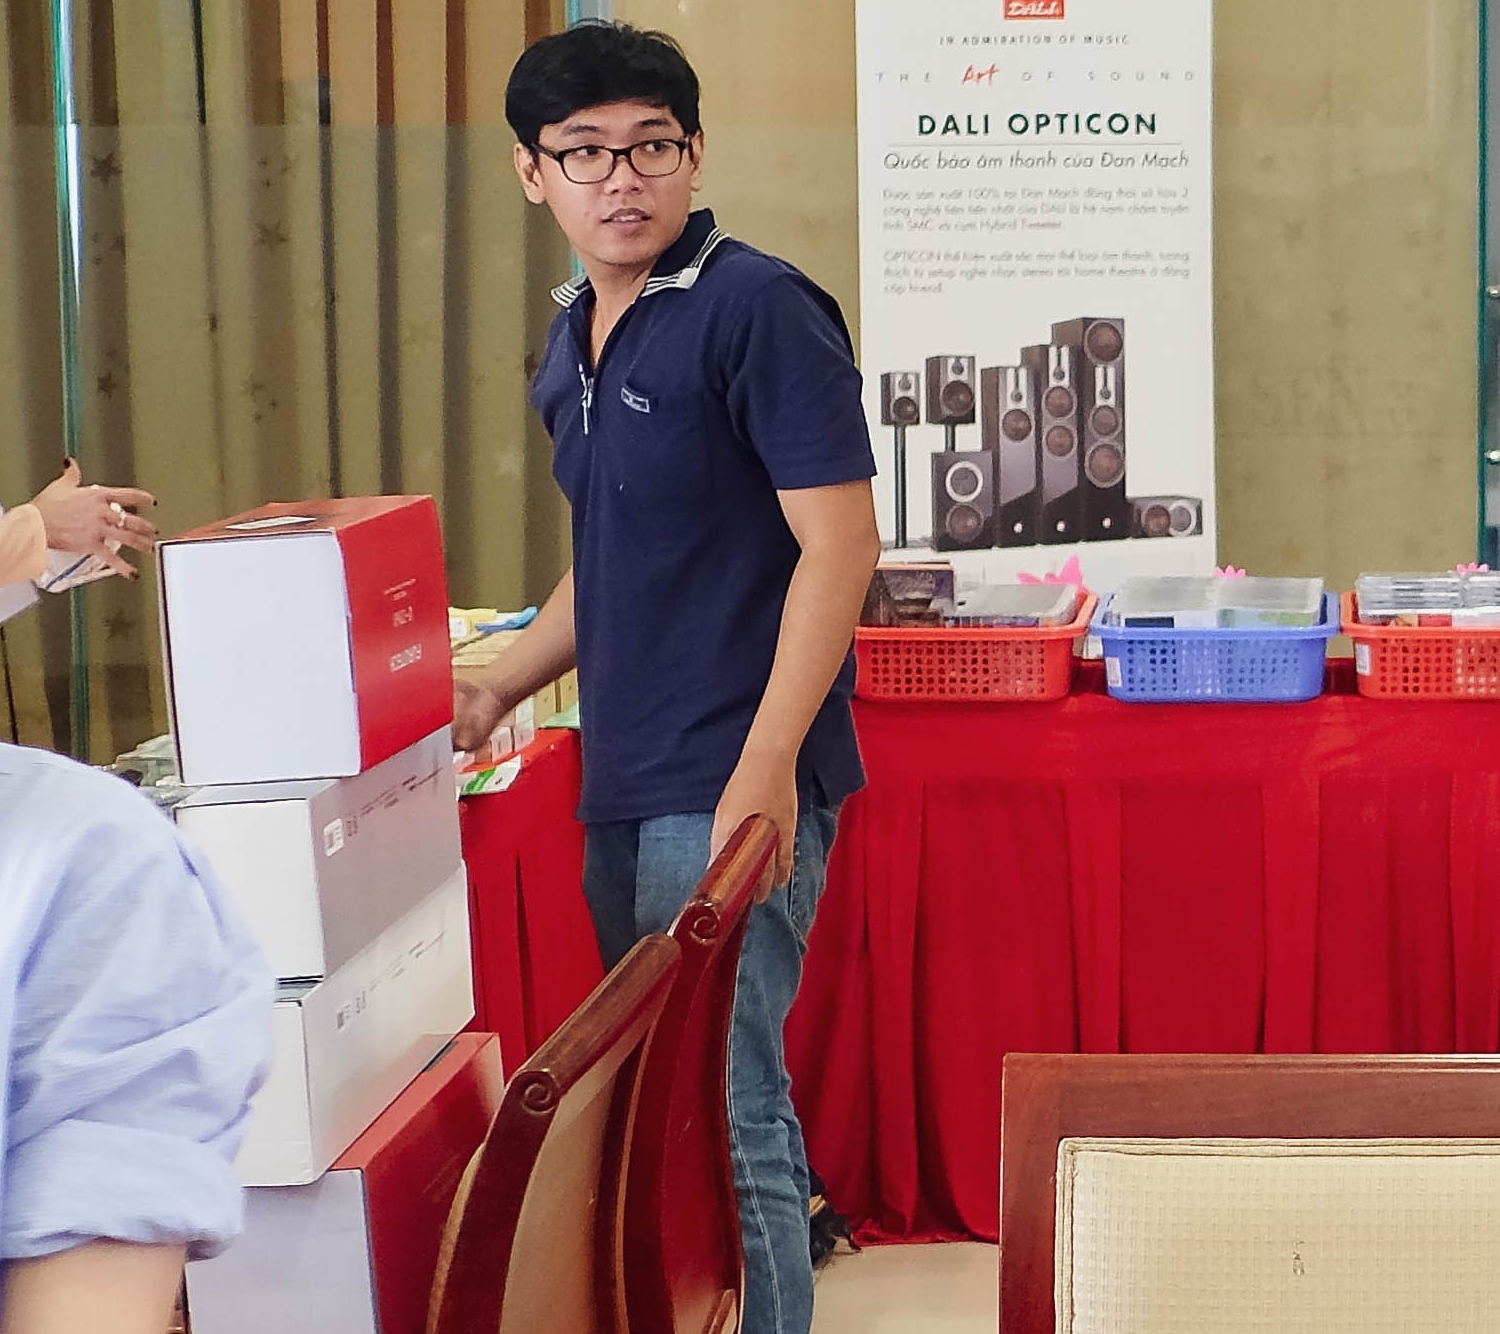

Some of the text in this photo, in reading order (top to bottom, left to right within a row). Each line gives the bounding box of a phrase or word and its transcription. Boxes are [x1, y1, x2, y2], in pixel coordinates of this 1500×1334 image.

[1007, 0, 1061, 17] DALI
[939, 34, 1131, 46] IN ADMIRATION OF MUSIC
[875, 63, 1197, 86] THE Art OF SOUND
[918, 112, 1158, 137] DALI OPTICON
[1009, 150, 1057, 169] thanh
